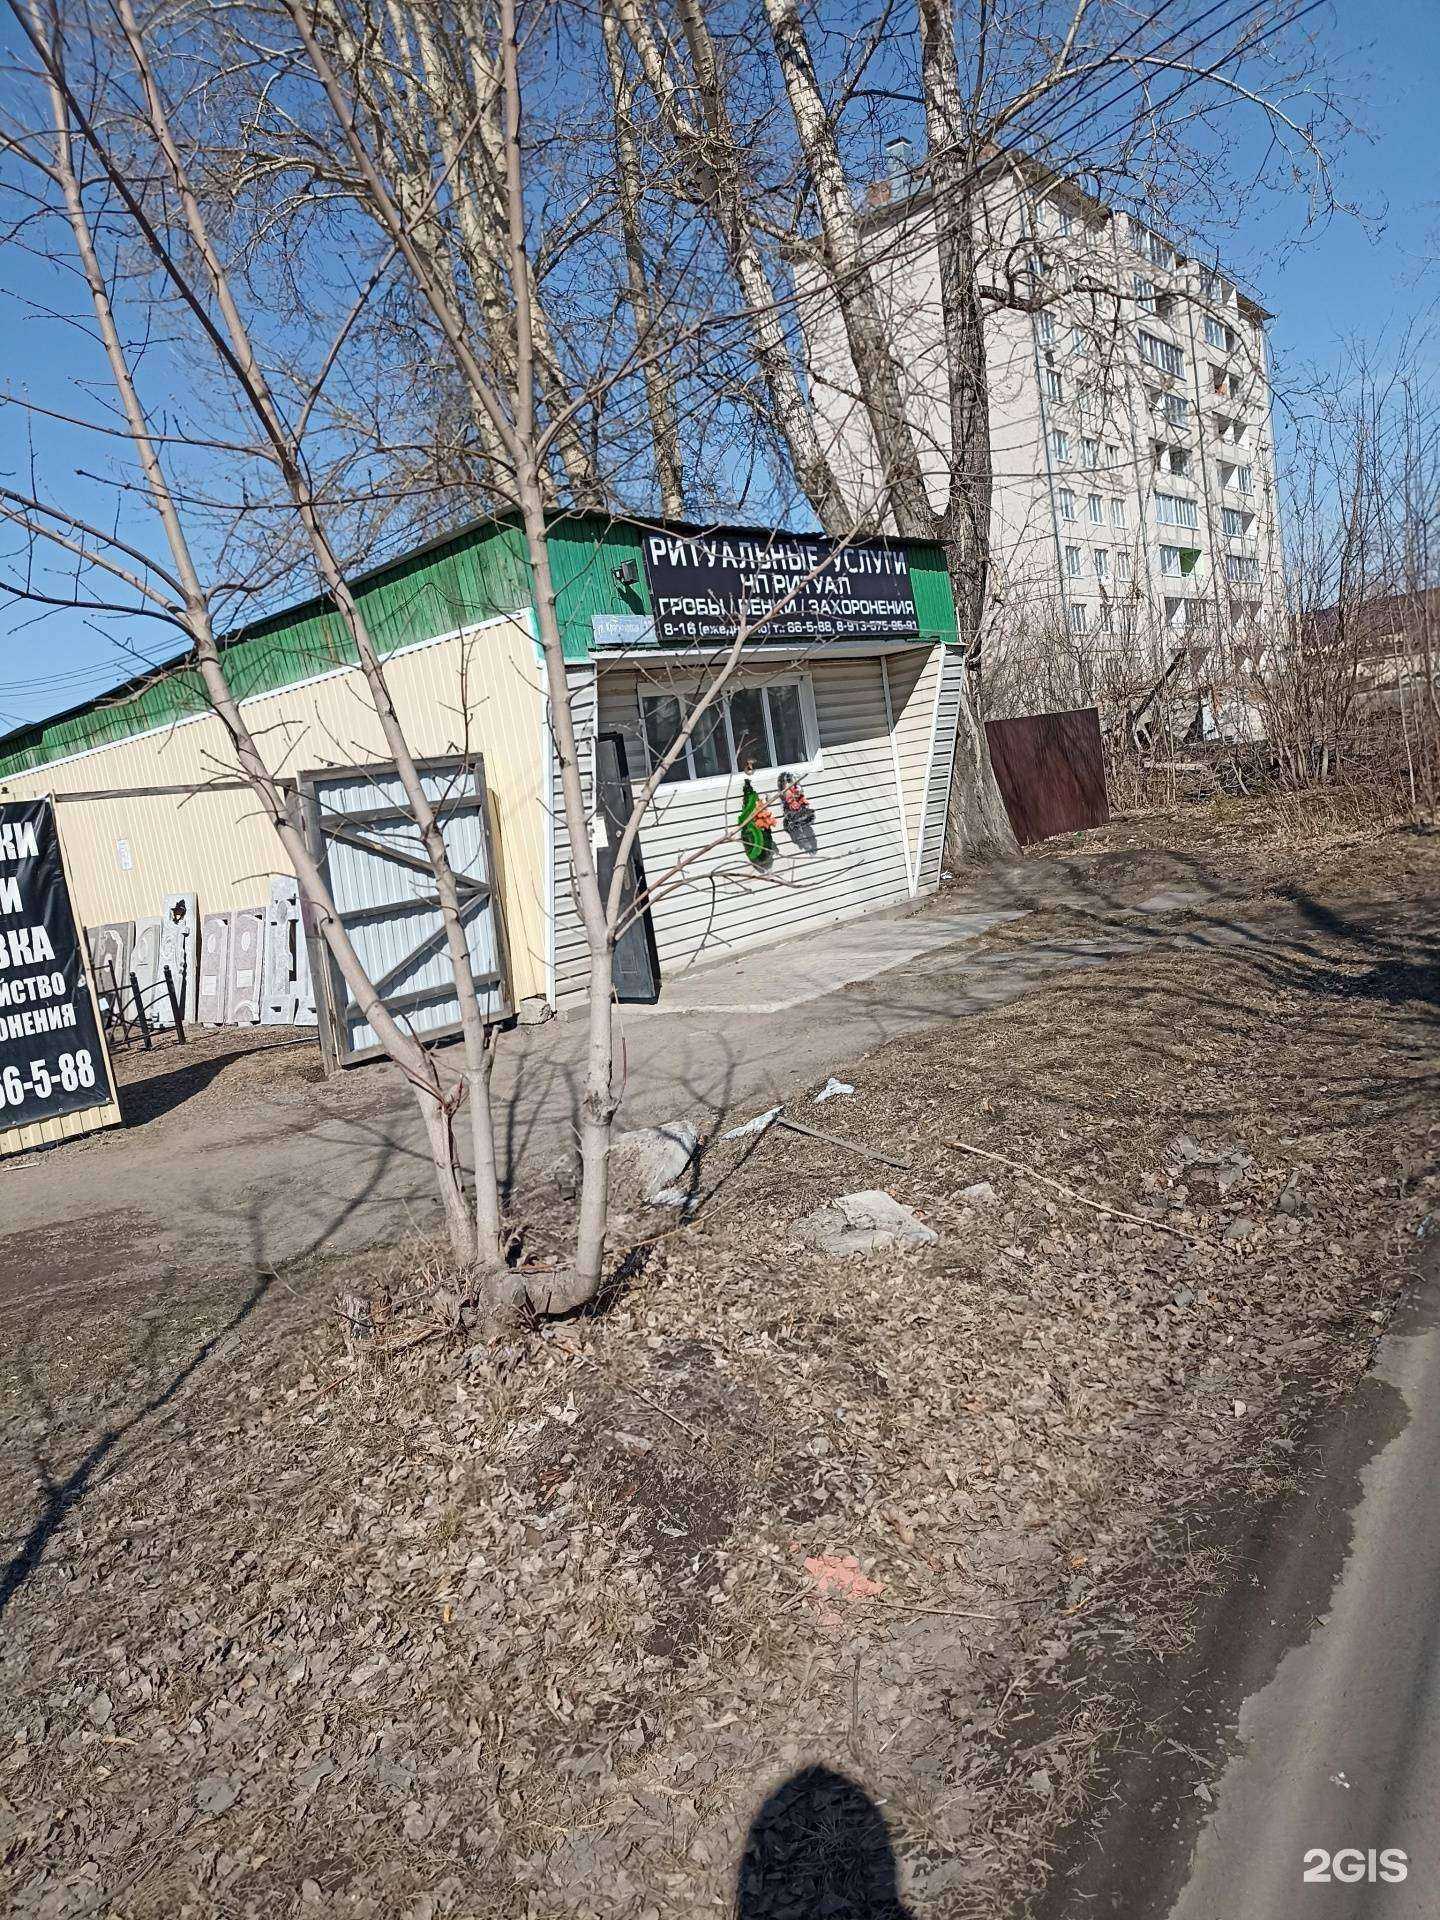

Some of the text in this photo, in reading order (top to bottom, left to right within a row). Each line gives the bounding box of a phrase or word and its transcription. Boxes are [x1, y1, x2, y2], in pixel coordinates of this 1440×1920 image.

[649, 536, 907, 575] РИТУАЛЬНЫЕ УСЛУГИ
[773, 574, 851, 595] РИТУАЛ
[658, 597, 727, 616] ГРОБЫ
[808, 599, 915, 615] ЗАХОРОНЕНИЯ
[664, 621, 697, 636] 8-16
